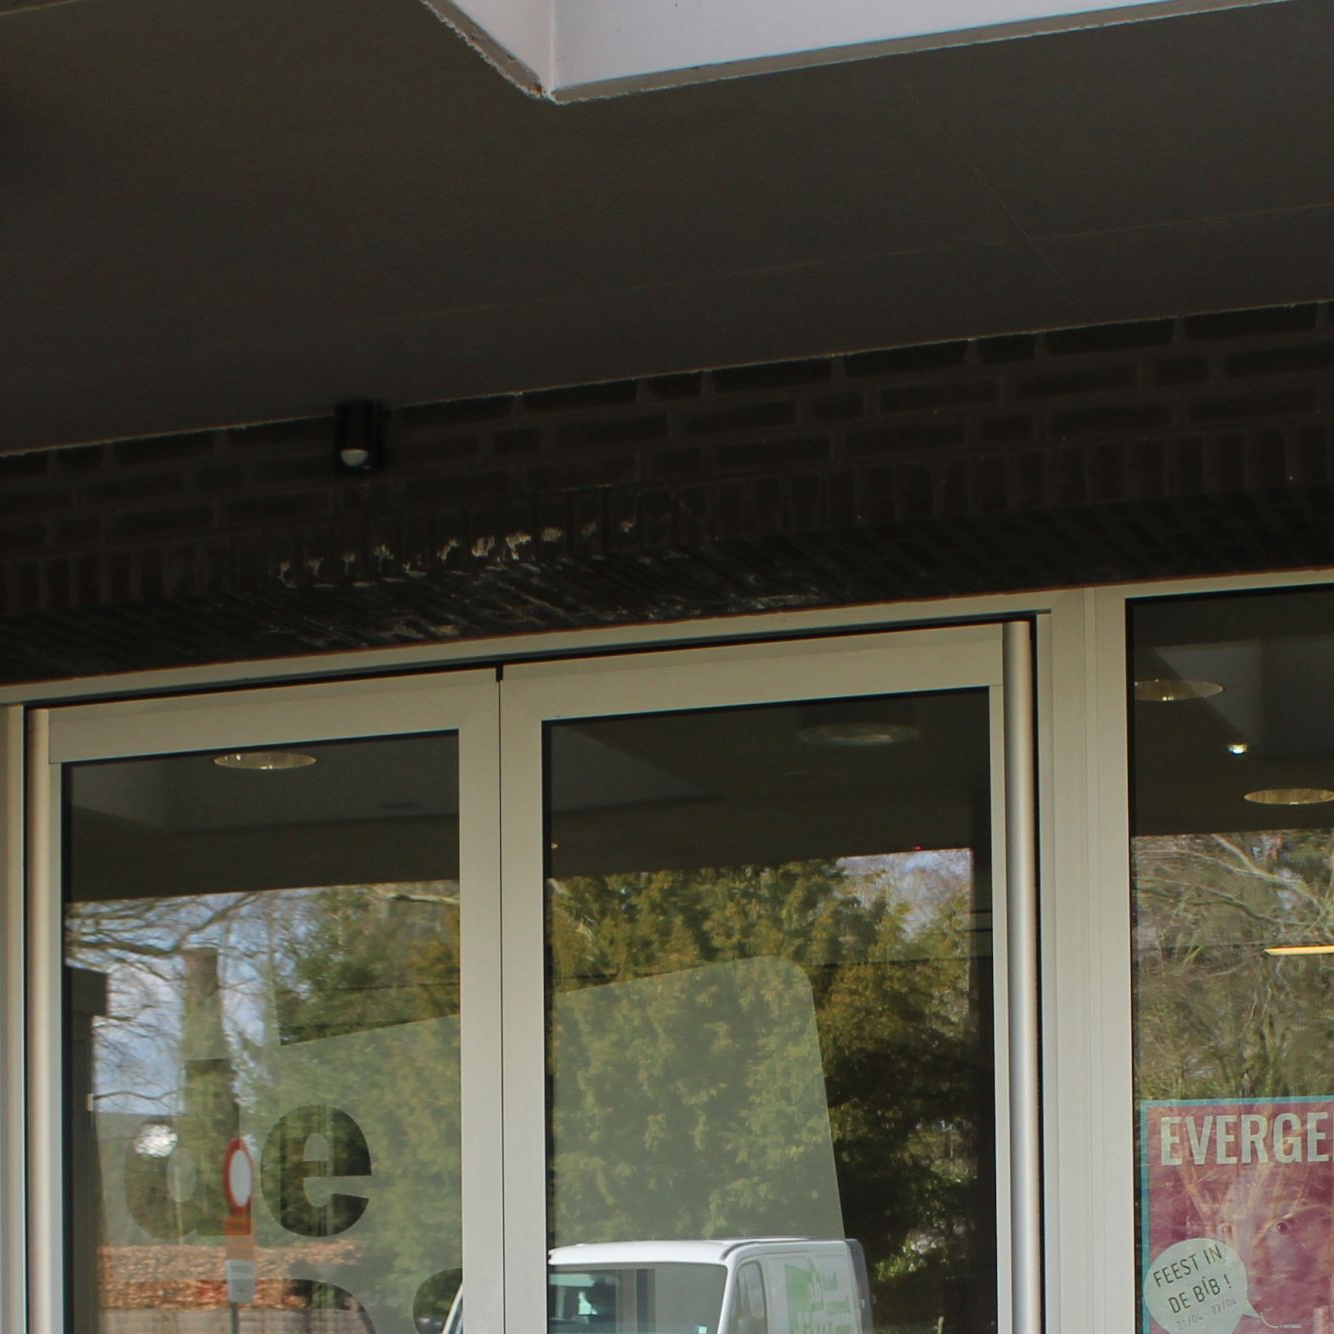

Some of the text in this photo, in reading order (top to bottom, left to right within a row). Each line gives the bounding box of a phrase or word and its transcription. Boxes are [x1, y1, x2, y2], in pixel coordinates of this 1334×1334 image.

[1152, 1244, 1223, 1288] FEEST IN
[1167, 1291, 1191, 1314] DE
